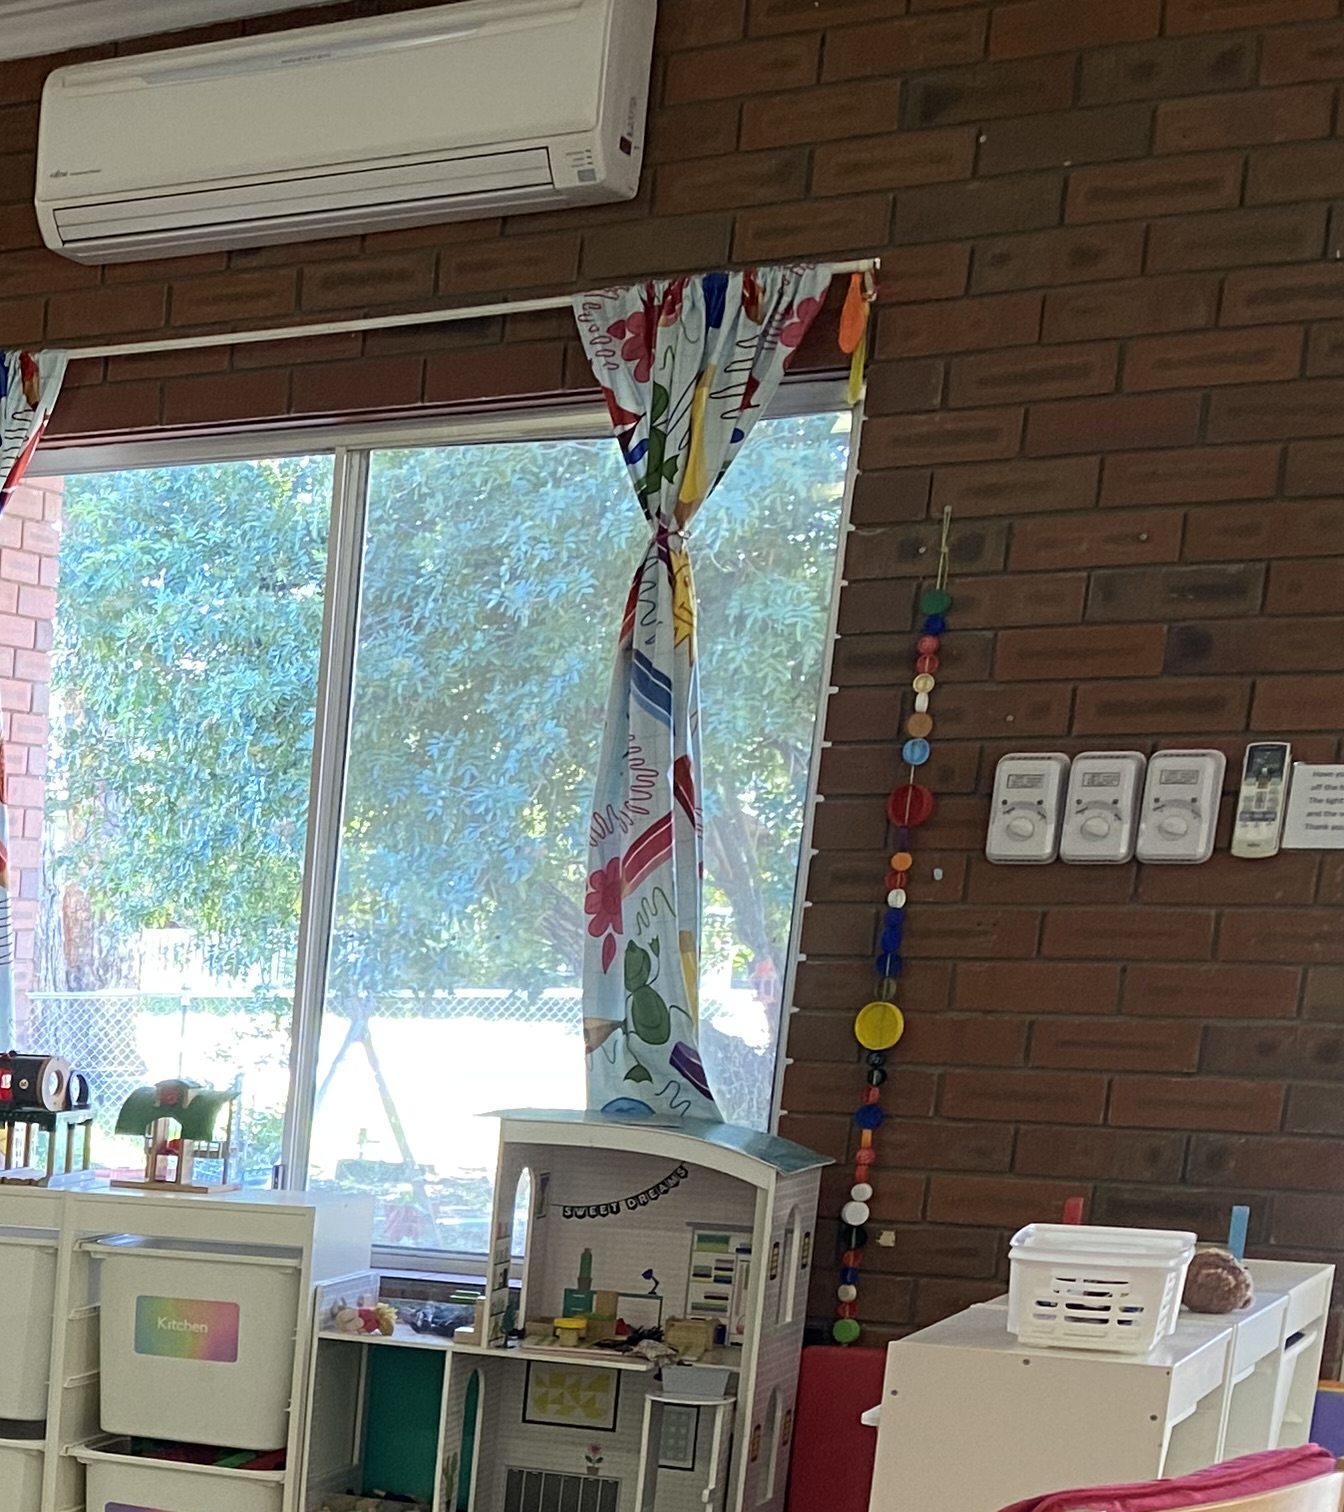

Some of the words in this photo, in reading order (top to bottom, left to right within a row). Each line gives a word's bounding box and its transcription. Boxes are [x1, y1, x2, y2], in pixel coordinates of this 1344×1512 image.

[564, 1202, 618, 1216] SWEET
[627, 1166, 687, 1208] DREAMS
[157, 1316, 209, 1333] Kitchen
